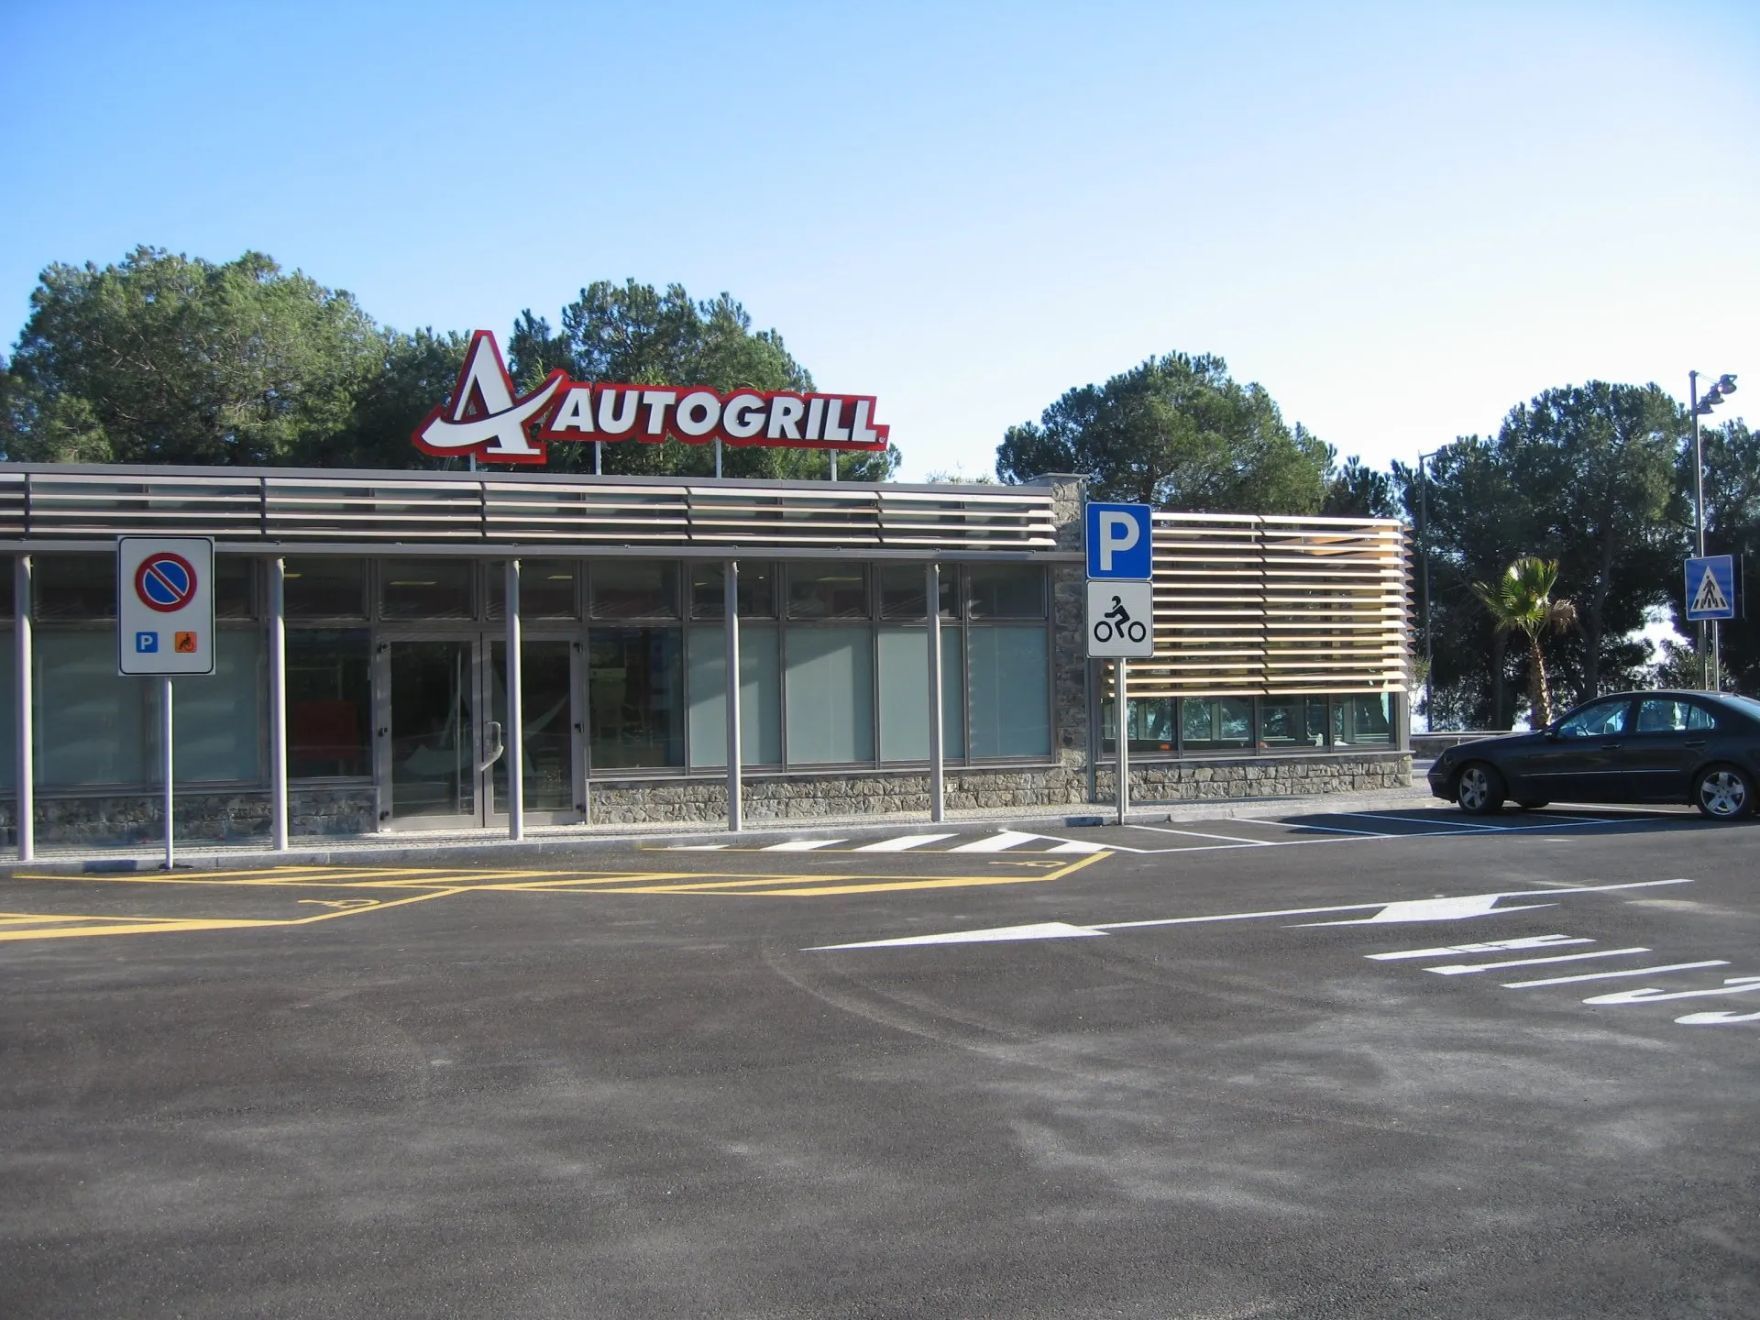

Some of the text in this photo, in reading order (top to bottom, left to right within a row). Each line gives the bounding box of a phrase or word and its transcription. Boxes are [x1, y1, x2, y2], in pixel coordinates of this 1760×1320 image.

[551, 388, 879, 443] AUTOGRILL
[1100, 511, 1140, 571] P
[141, 635, 153, 650] P
